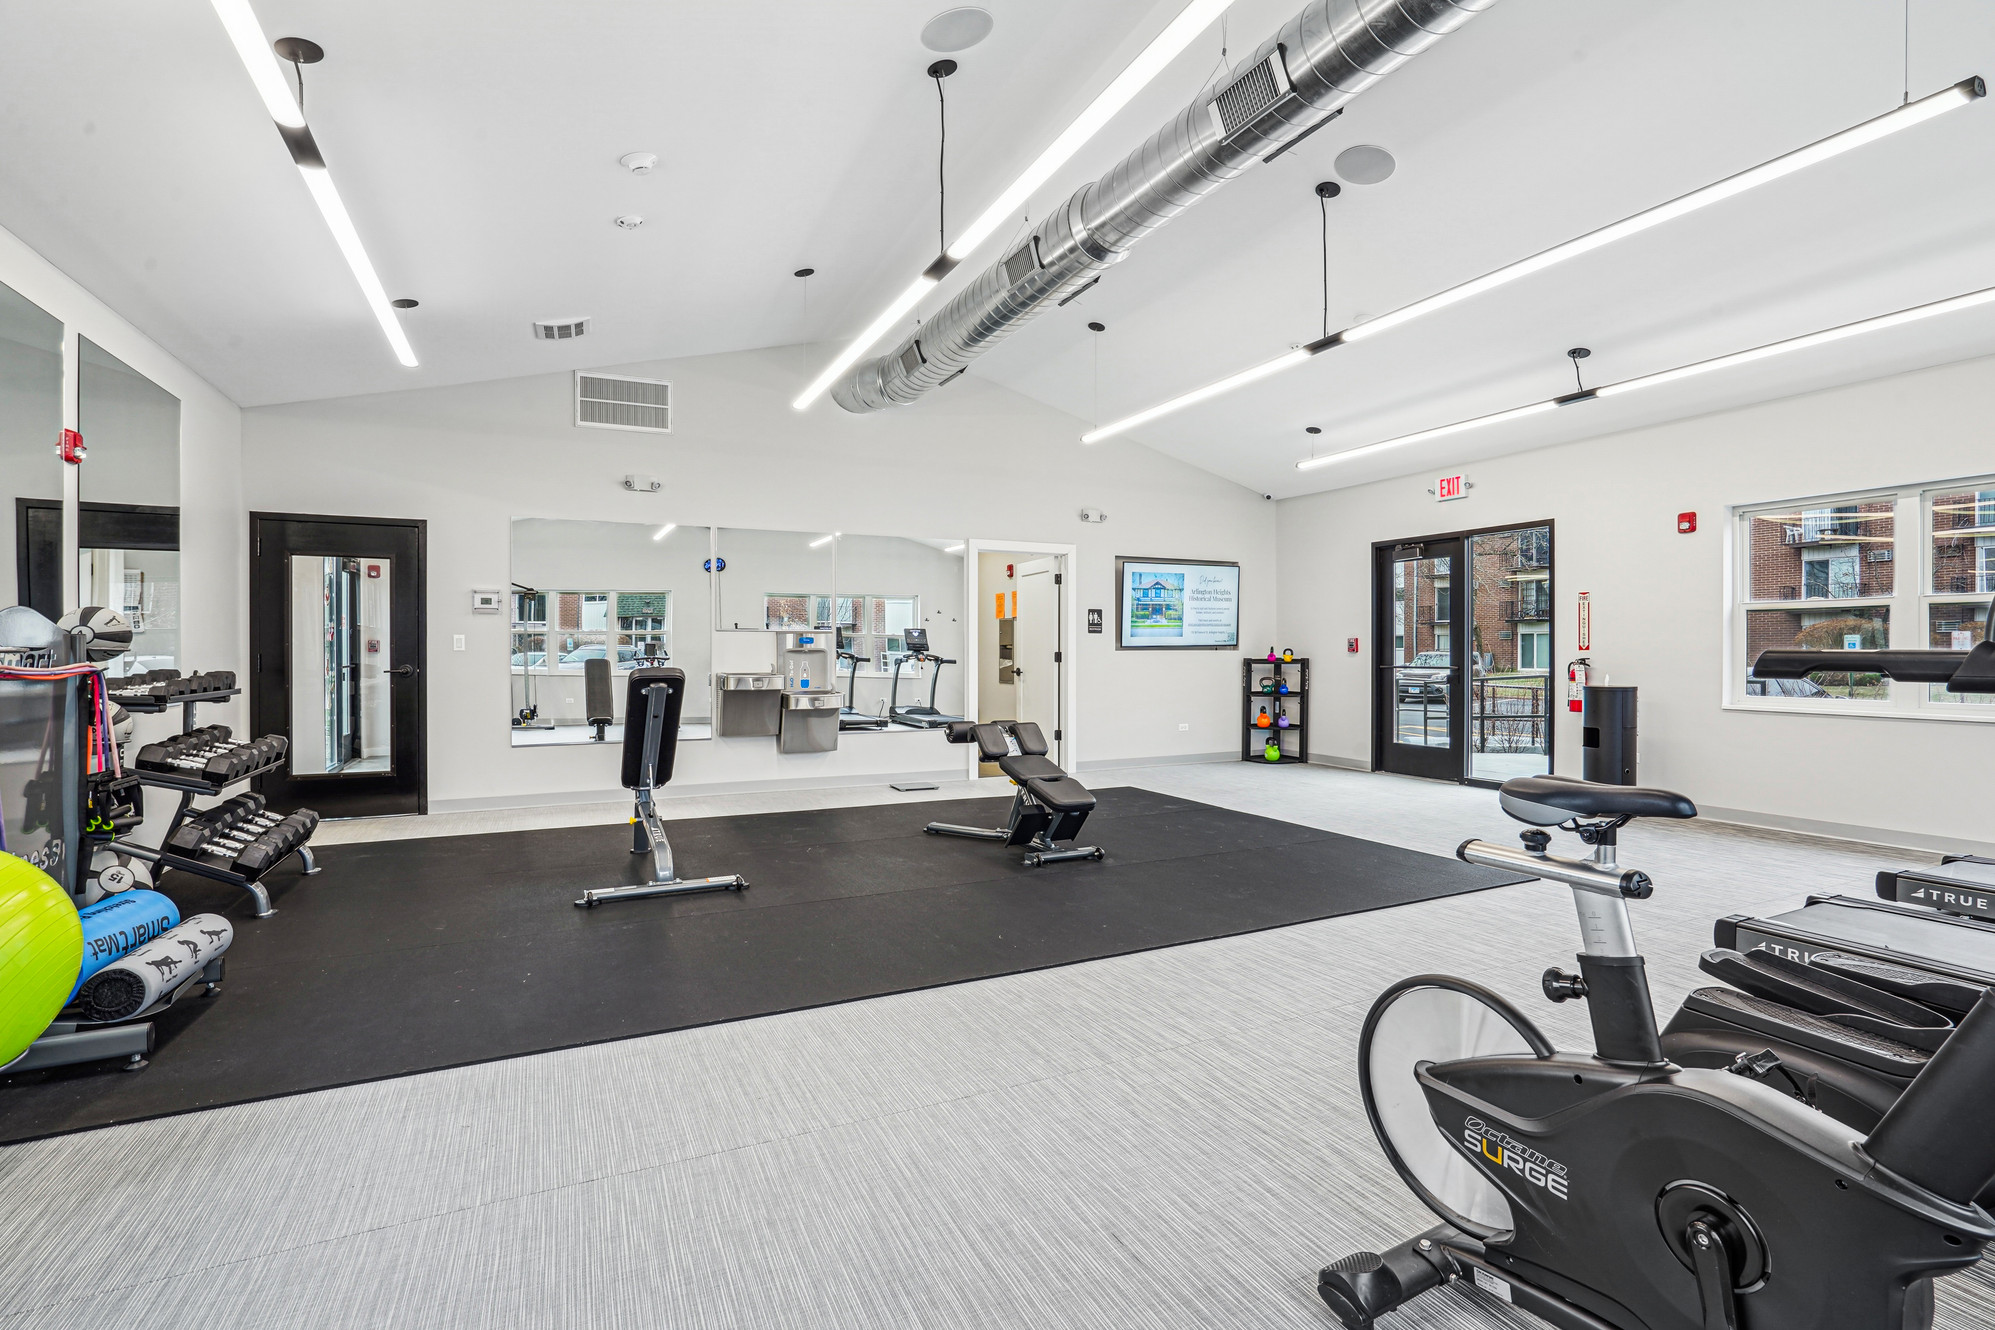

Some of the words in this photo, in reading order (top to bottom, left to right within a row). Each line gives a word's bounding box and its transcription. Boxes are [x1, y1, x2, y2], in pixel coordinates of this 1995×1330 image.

[1440, 476, 1461, 497] EXIT
[108, 872, 123, 885] 15
[1928, 889, 1988, 910] TRUE
[1770, 943, 1812, 964] TR
[1464, 1115, 1568, 1177] Octane
[1464, 1129, 1569, 1200] SURGE
